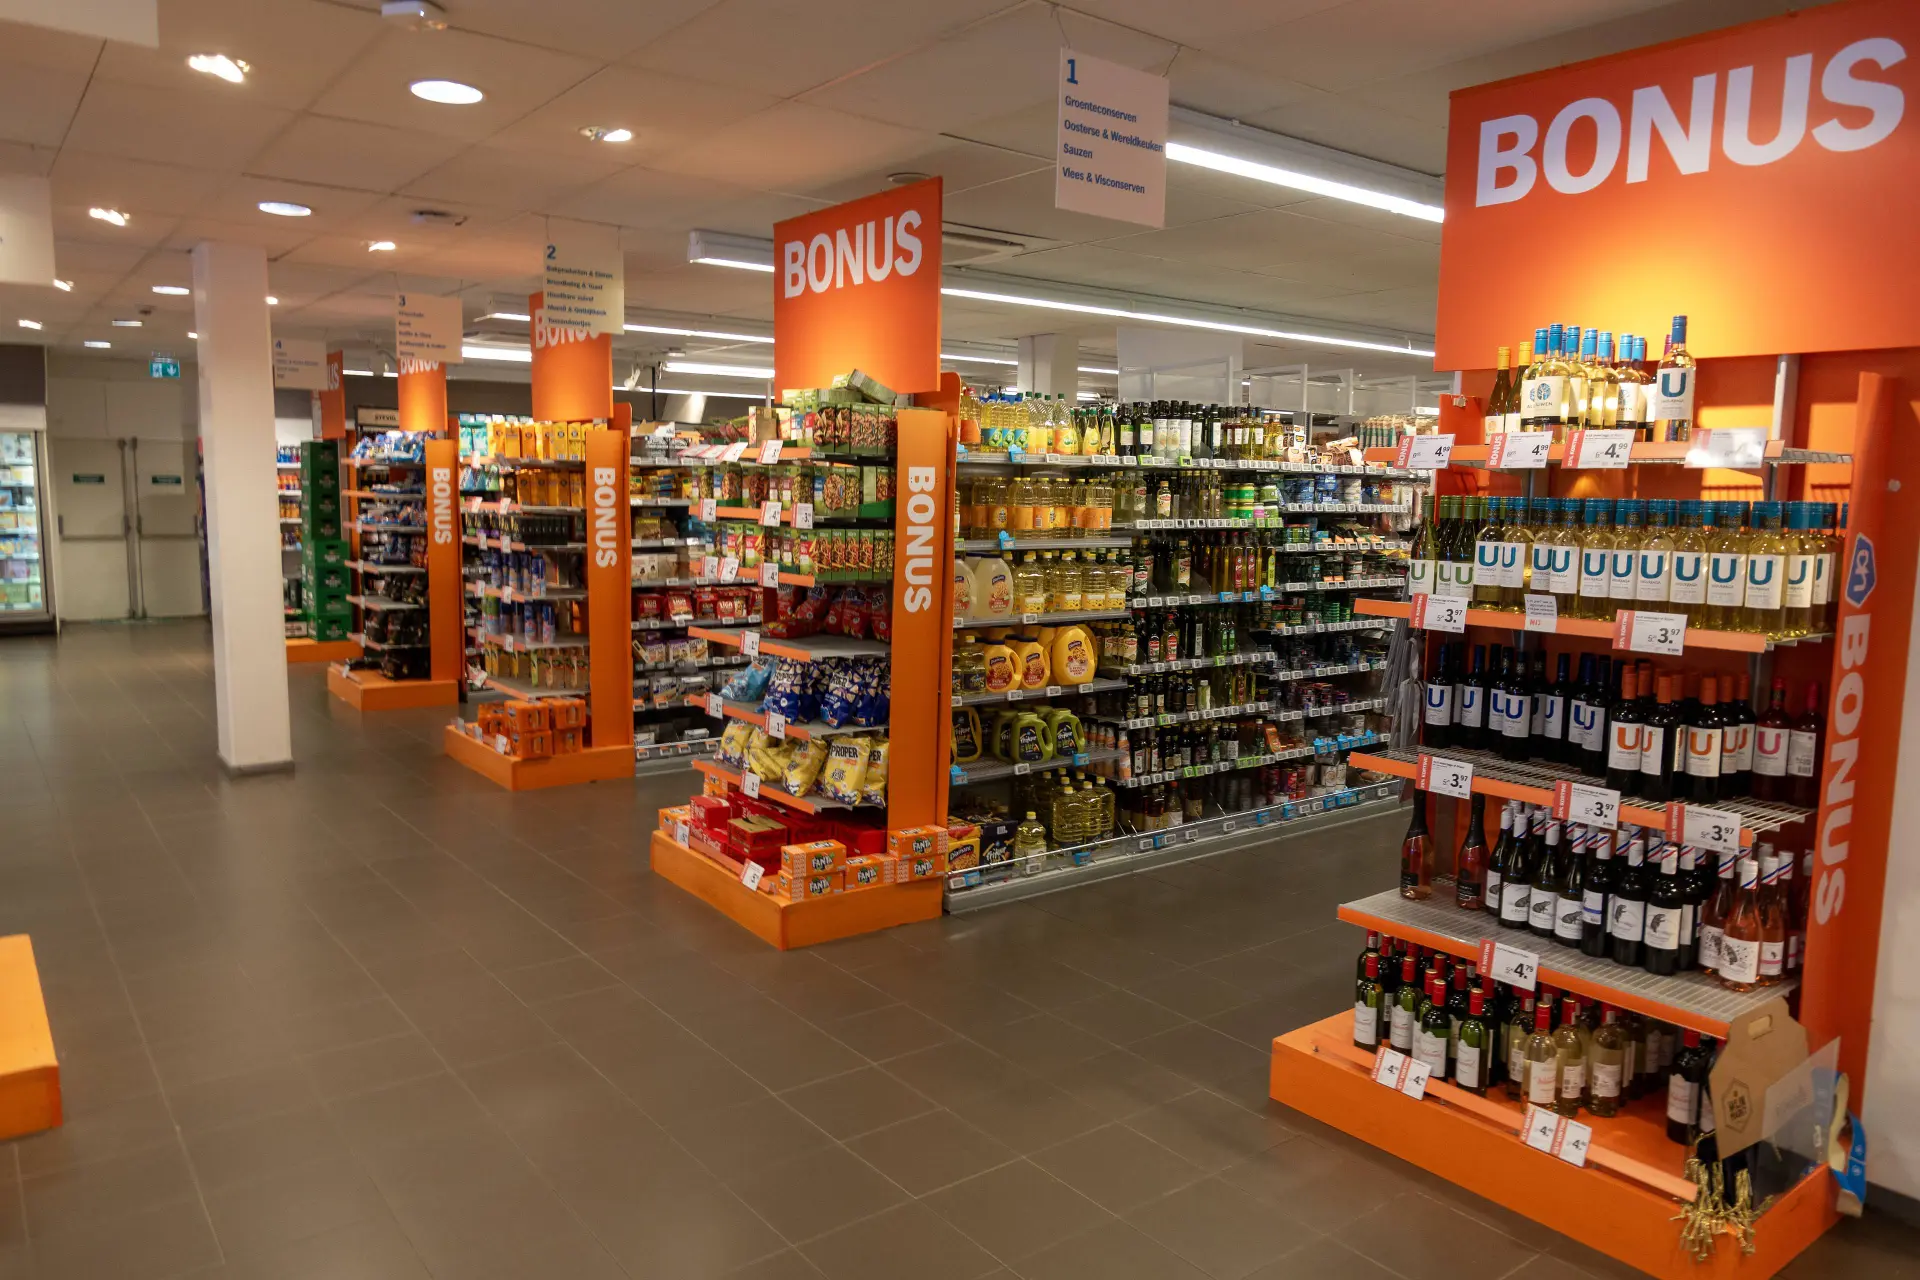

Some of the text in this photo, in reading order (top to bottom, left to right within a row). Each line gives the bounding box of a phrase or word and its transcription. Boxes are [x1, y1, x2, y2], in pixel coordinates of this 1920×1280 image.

[1066, 59, 1078, 84] 1
[1065, 96, 1137, 123] Groenteconserven
[1475, 37, 1907, 208] BONUS
[1064, 120, 1163, 152] Oosterse & Wereldkeuken
[1063, 144, 1093, 159] Sauzen
[1062, 167, 1145, 194] Vlees & Visconserven
[546, 244, 556, 260] 2
[784, 210, 922, 299] BONUS
[399, 295, 406, 307] 3
[1398, 438, 1410, 466] BONUS
[1490, 435, 1503, 466] BONUS
[432, 468, 452, 544] BONUS
[594, 468, 617, 568] BONUS
[904, 467, 935, 613] BONUS
[1479, 546, 1498, 566] U
[1552, 550, 1570, 572] U
[1584, 553, 1605, 576] U
[1613, 554, 1632, 577] U
[1641, 555, 1663, 578] U
[1455, 567, 1473, 584] U
[1676, 556, 1700, 581] U
[1712, 558, 1737, 583] U
[1749, 560, 1773, 585] U
[1444, 609, 1463, 623] 3.97
[1658, 628, 1680, 644] 3.97
[1506, 698, 1523, 719] U
[830, 746, 858, 758] PROPER
[869, 750, 881, 760] PER
[1816, 614, 1871, 926] BONUS
[1450, 774, 1468, 788] 3.97
[1594, 802, 1614, 818] 3.97
[1711, 825, 1734, 842] 3.97
[913, 841, 931, 852] FANTA
[812, 856, 832, 868] FANTA
[914, 862, 932, 874] FANTA
[858, 868, 877, 882] FANTA
[810, 880, 830, 892] FANTA
[1514, 963, 1533, 979] 4.79
